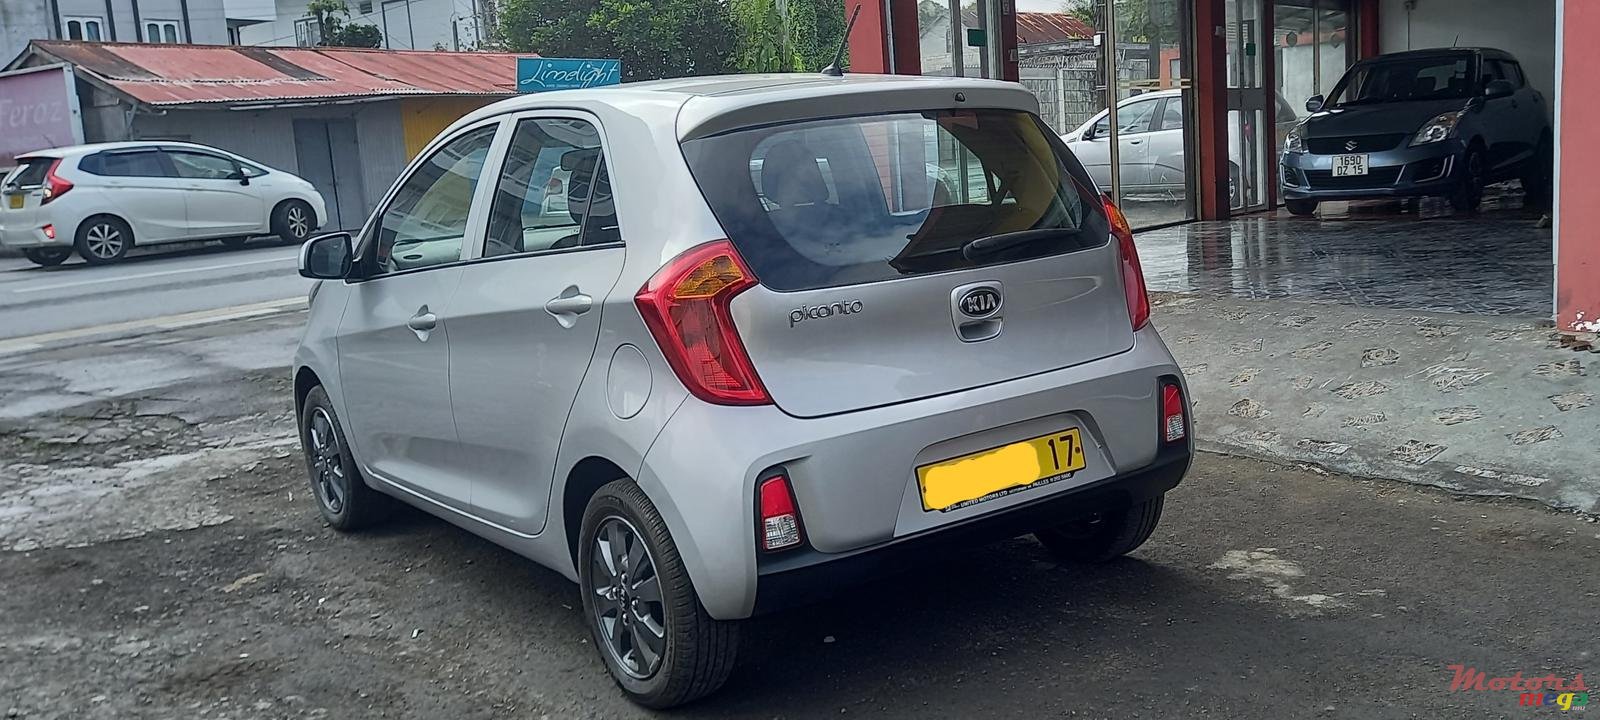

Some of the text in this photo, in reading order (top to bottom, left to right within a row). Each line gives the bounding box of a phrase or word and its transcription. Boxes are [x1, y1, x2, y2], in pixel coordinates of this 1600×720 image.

[520, 60, 618, 88] Limelight
[1340, 155, 1361, 165] 1690
[1337, 164, 1363, 176] DZ 15
[967, 293, 996, 312] KIA
[789, 299, 863, 328] picanto
[1048, 434, 1073, 470] 17
[960, 499, 979, 508] UNITED
